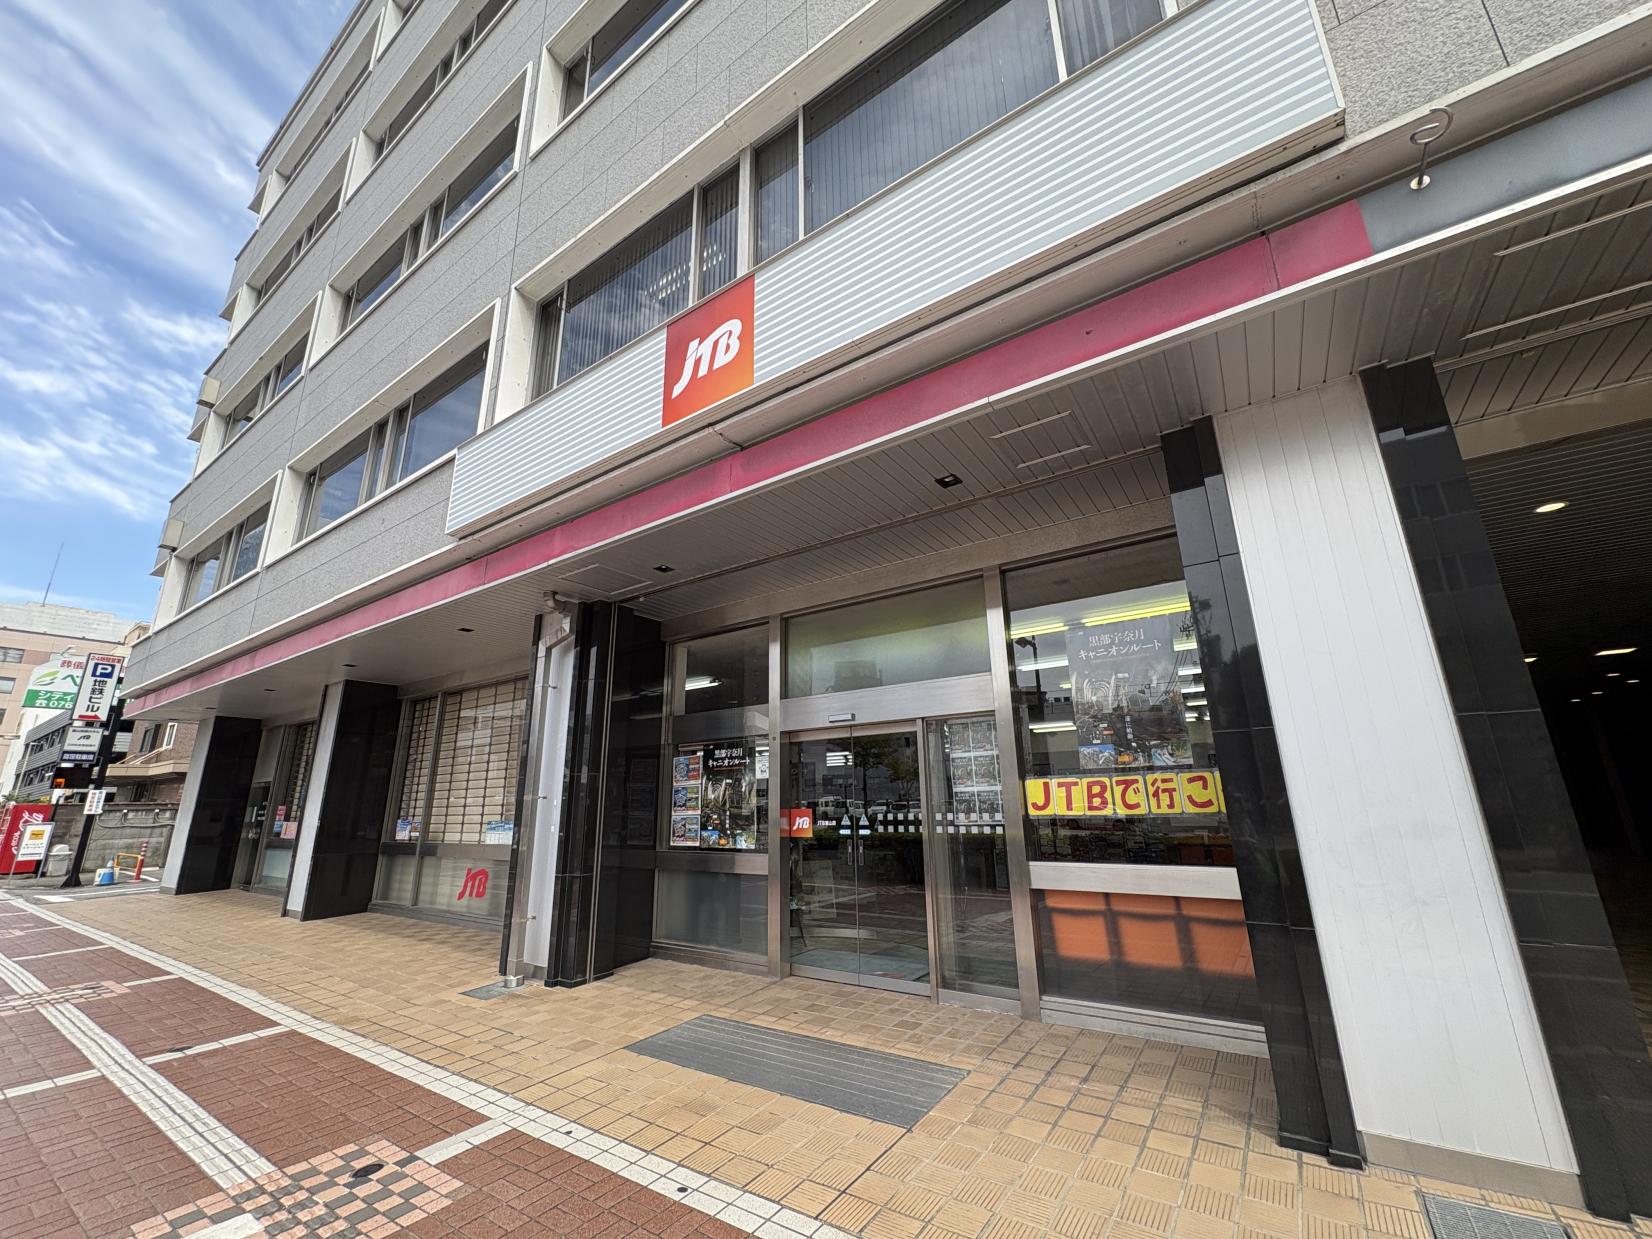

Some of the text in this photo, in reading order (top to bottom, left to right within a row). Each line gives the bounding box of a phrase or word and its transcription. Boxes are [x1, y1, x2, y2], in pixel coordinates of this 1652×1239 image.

[671, 318, 743, 400] JTB
[1089, 628, 1144, 648] 黒部宇奈月
[1078, 640, 1162, 661] キャニオンルート
[95, 664, 112, 676] P
[85, 679, 107, 712] 地鉄ビル
[708, 756, 750, 767] キャニオンルート
[793, 816, 810, 831] JTB
[457, 867, 489, 901] JTB
